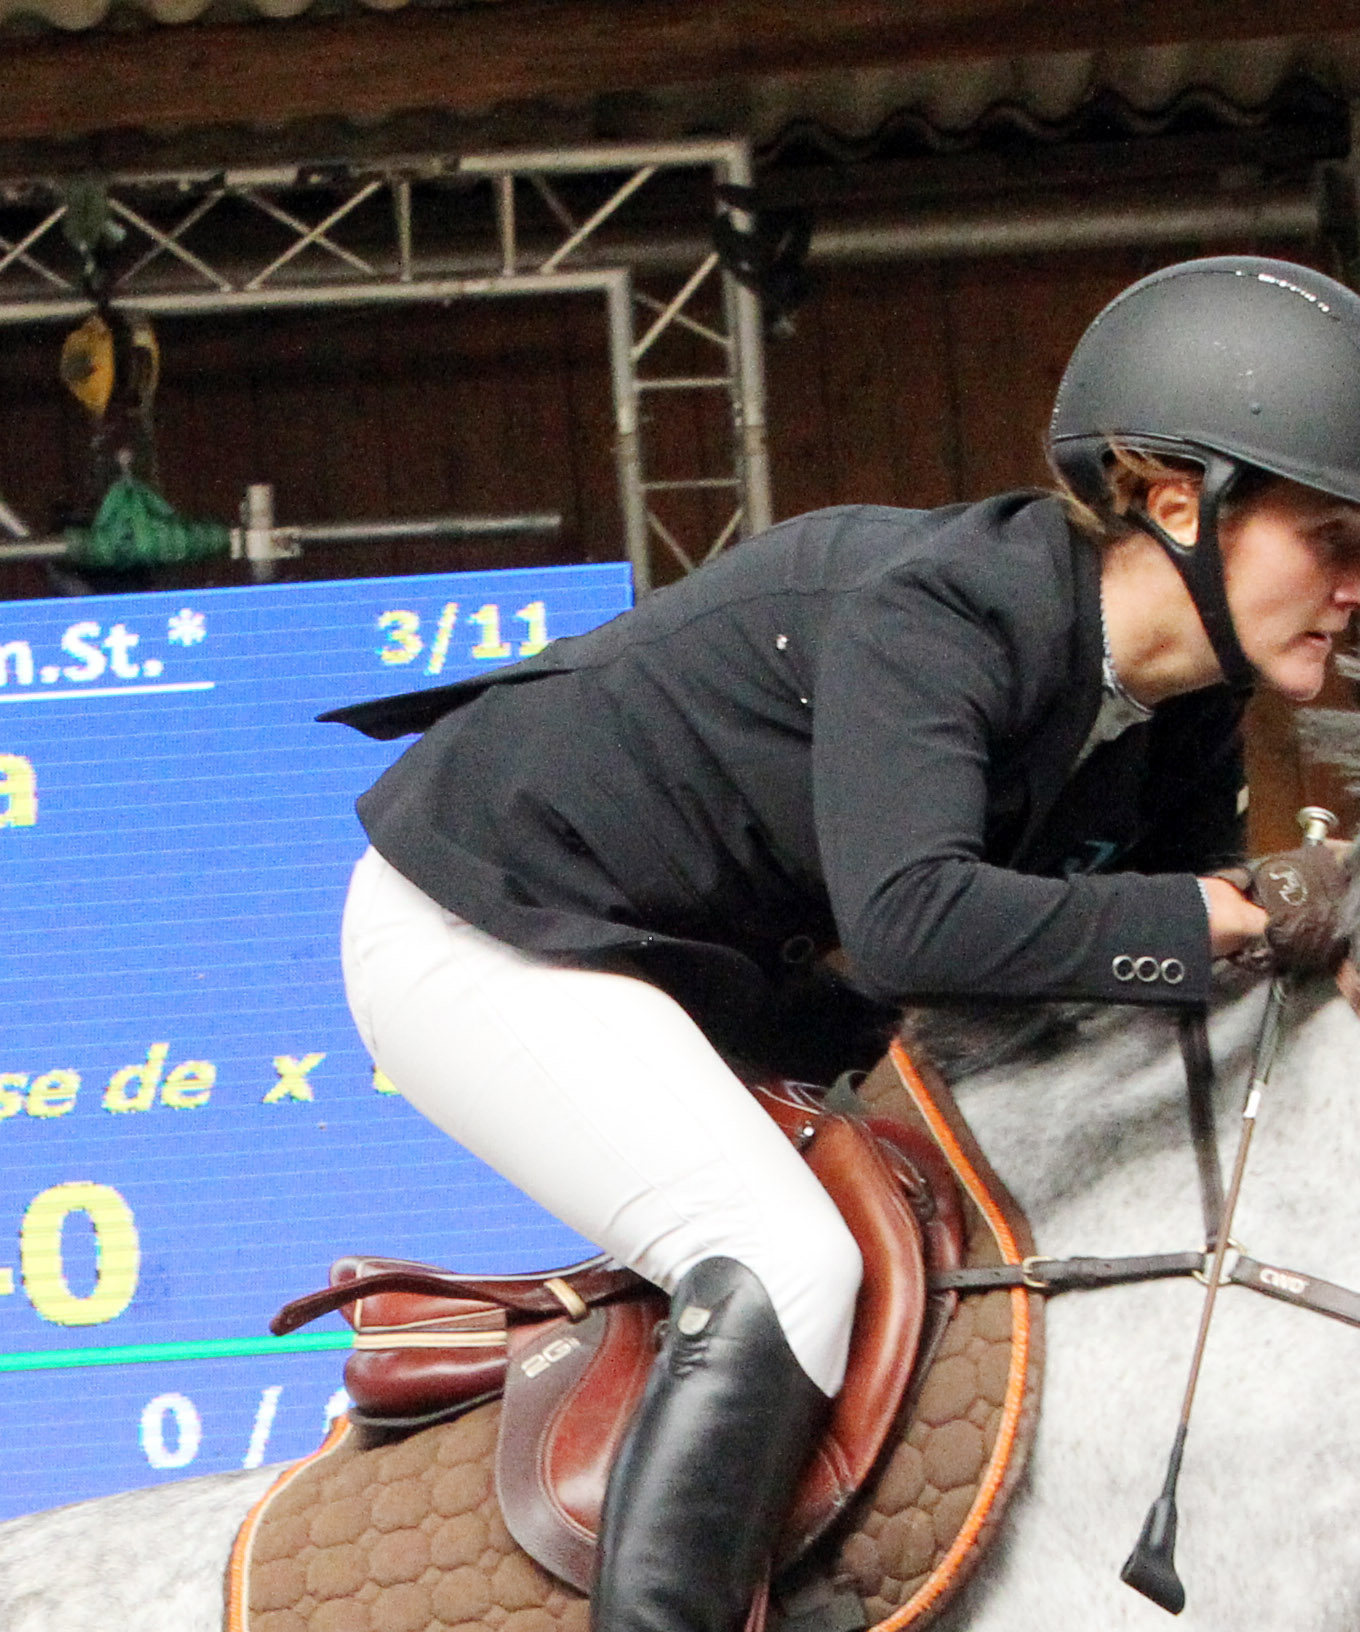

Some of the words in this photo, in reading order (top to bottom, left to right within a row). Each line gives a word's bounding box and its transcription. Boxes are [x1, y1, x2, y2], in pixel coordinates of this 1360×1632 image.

[377, 601, 551, 674] 3/11
[101, 1042, 218, 1115] de
[263, 1052, 326, 1104] x
[140, 1392, 203, 1470] 0
